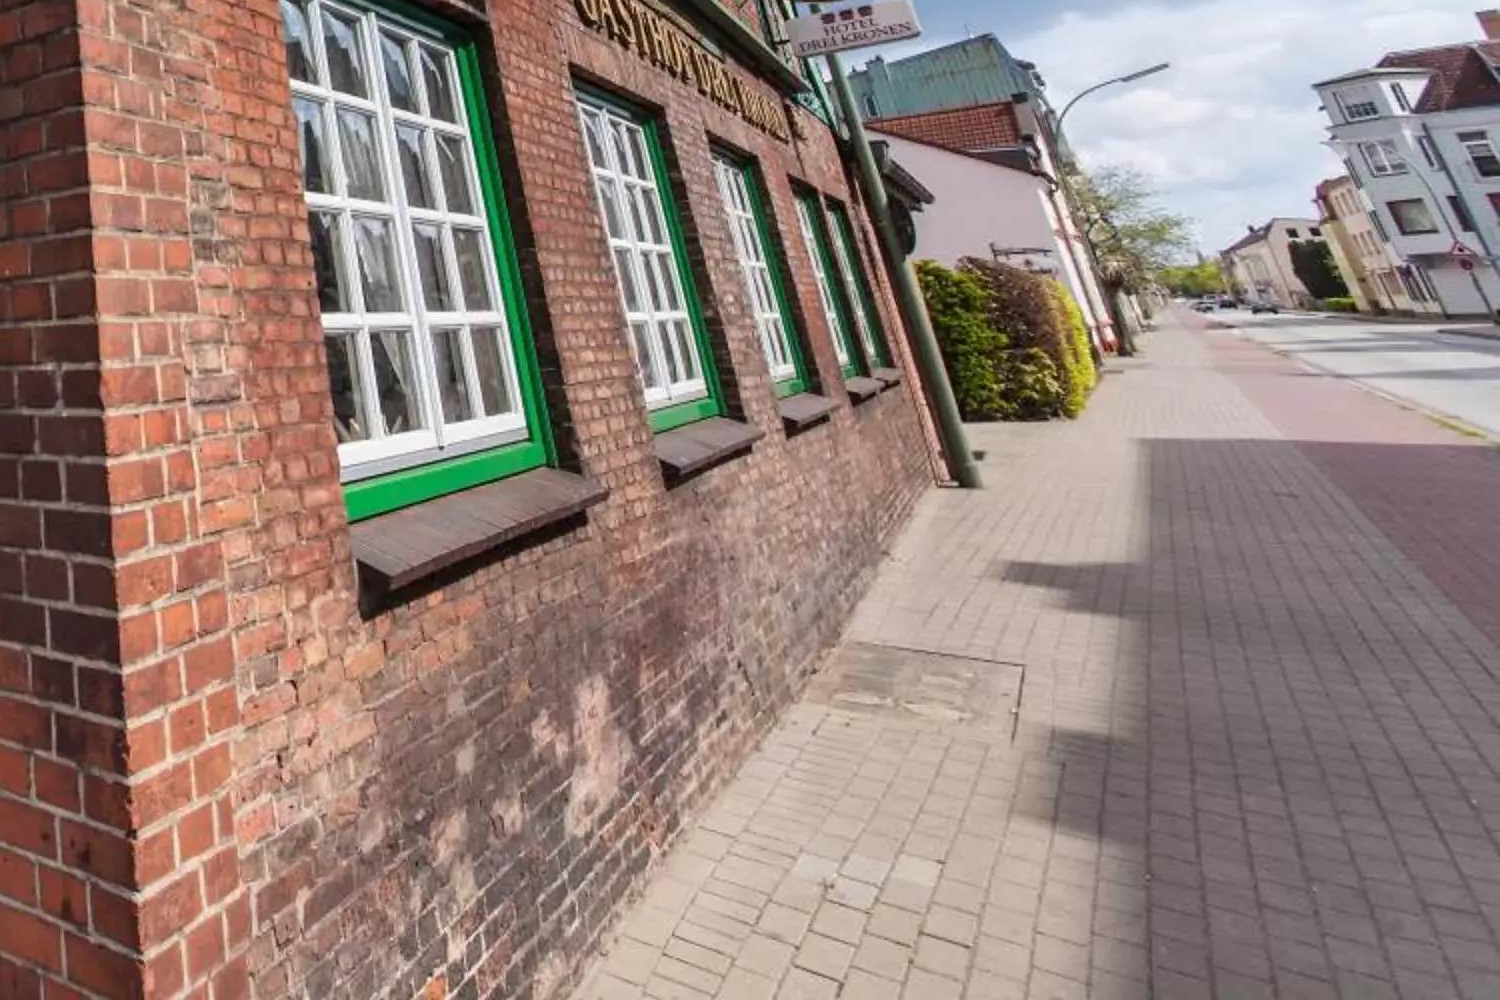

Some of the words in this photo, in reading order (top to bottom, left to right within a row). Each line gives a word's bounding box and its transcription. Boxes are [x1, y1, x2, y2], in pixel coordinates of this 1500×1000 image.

[799, 37, 839, 53] DREI
[840, 21, 912, 44] KRONEN
[823, 17, 878, 36] HOTEL
